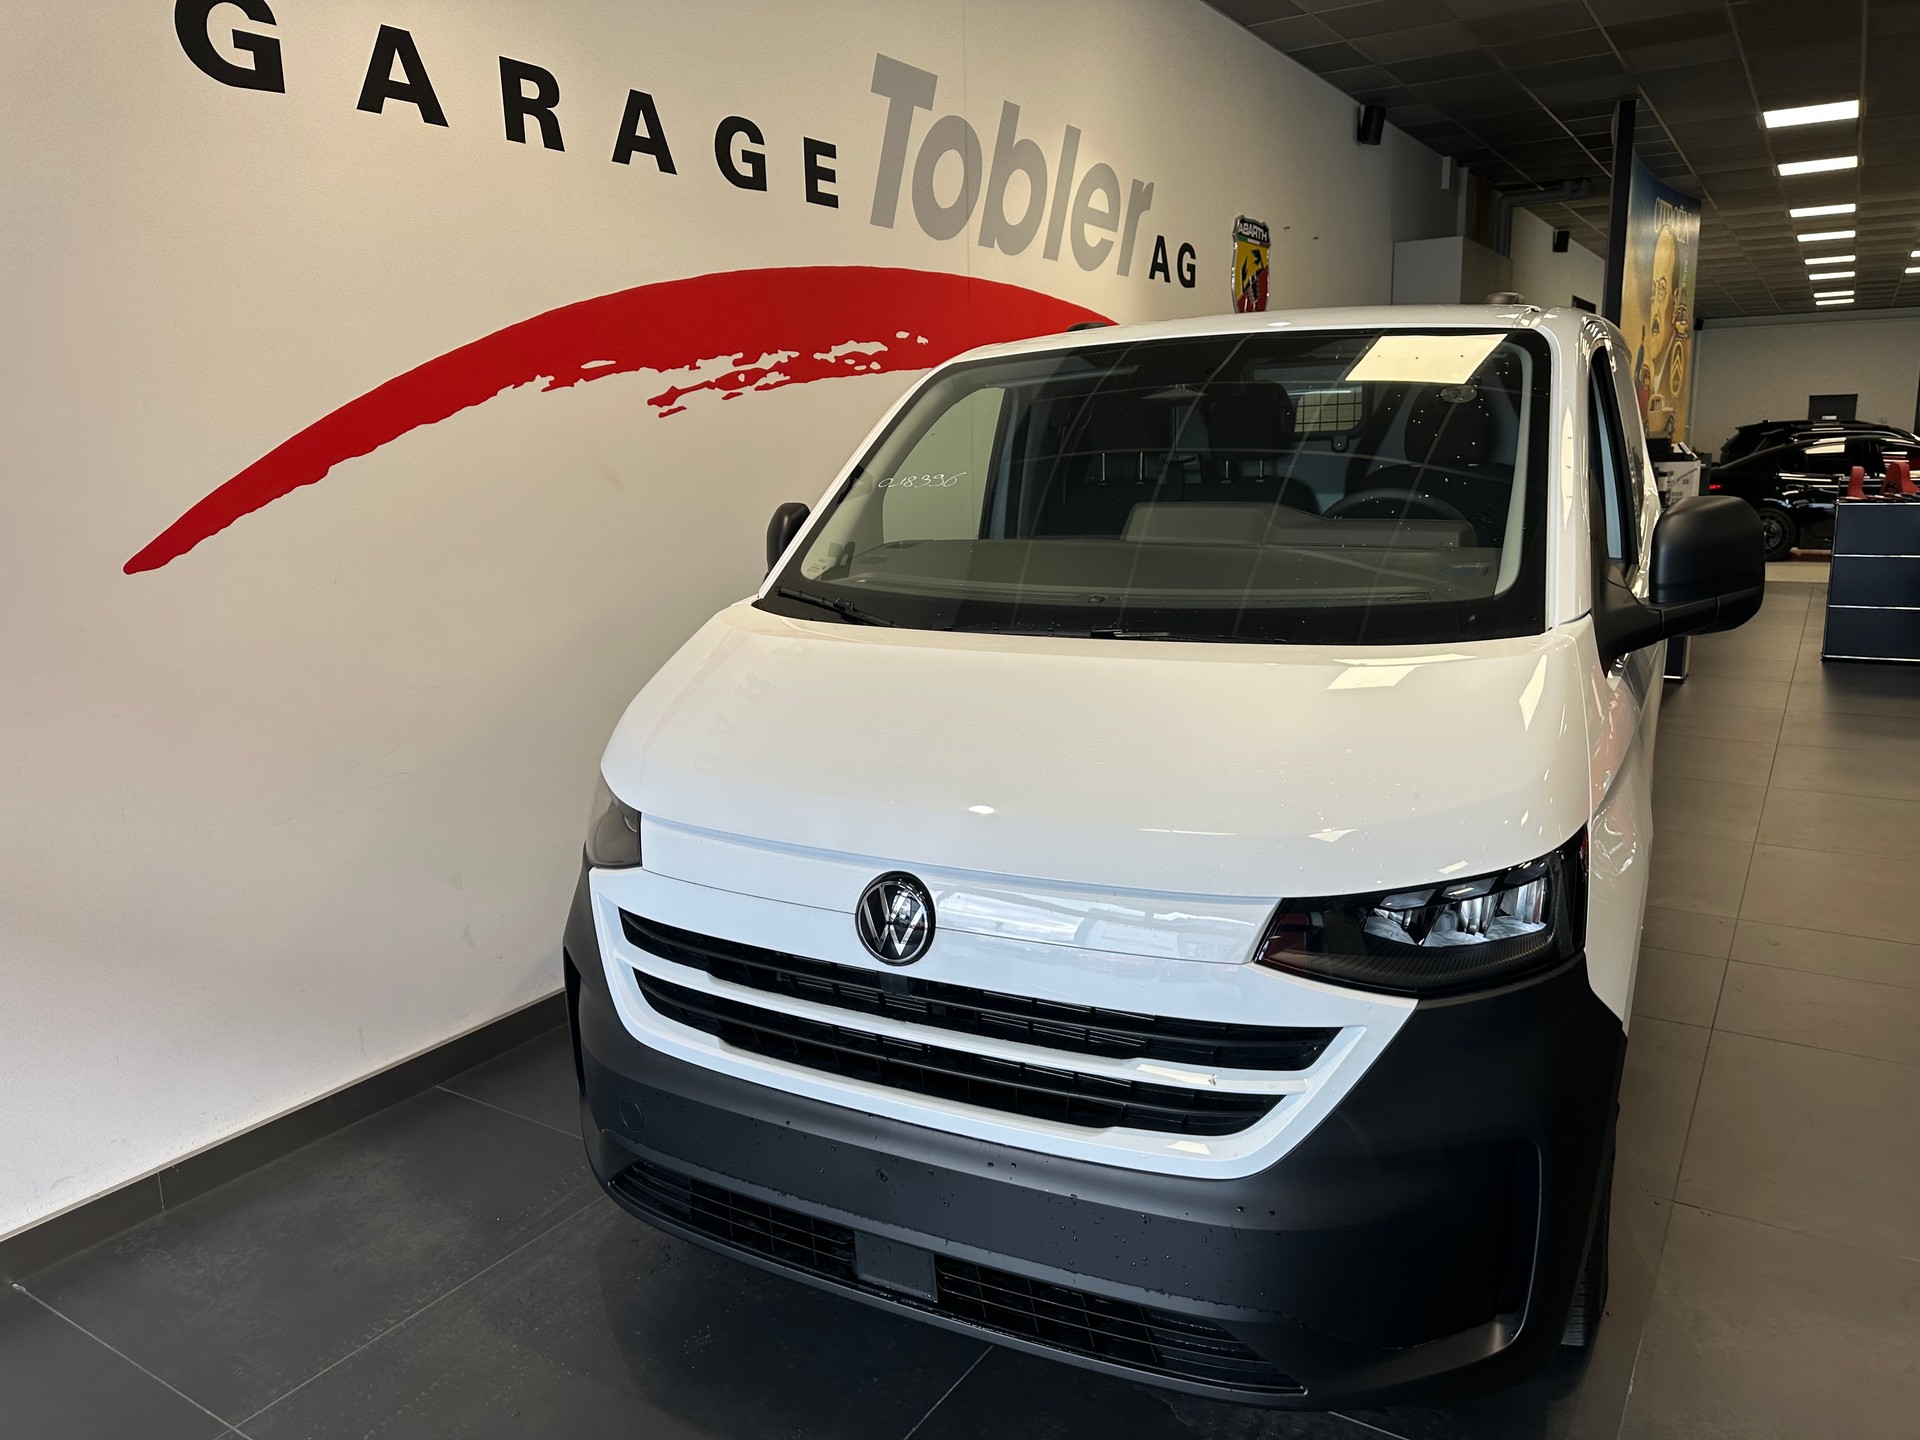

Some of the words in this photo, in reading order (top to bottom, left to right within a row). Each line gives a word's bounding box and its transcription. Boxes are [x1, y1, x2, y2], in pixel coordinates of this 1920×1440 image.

[174, 0, 839, 208] GARAGE
[870, 53, 1154, 277] Tobler
[1149, 235, 1196, 289] AG
[1238, 223, 1268, 241] ABARTH
[859, 880, 928, 961] VW
